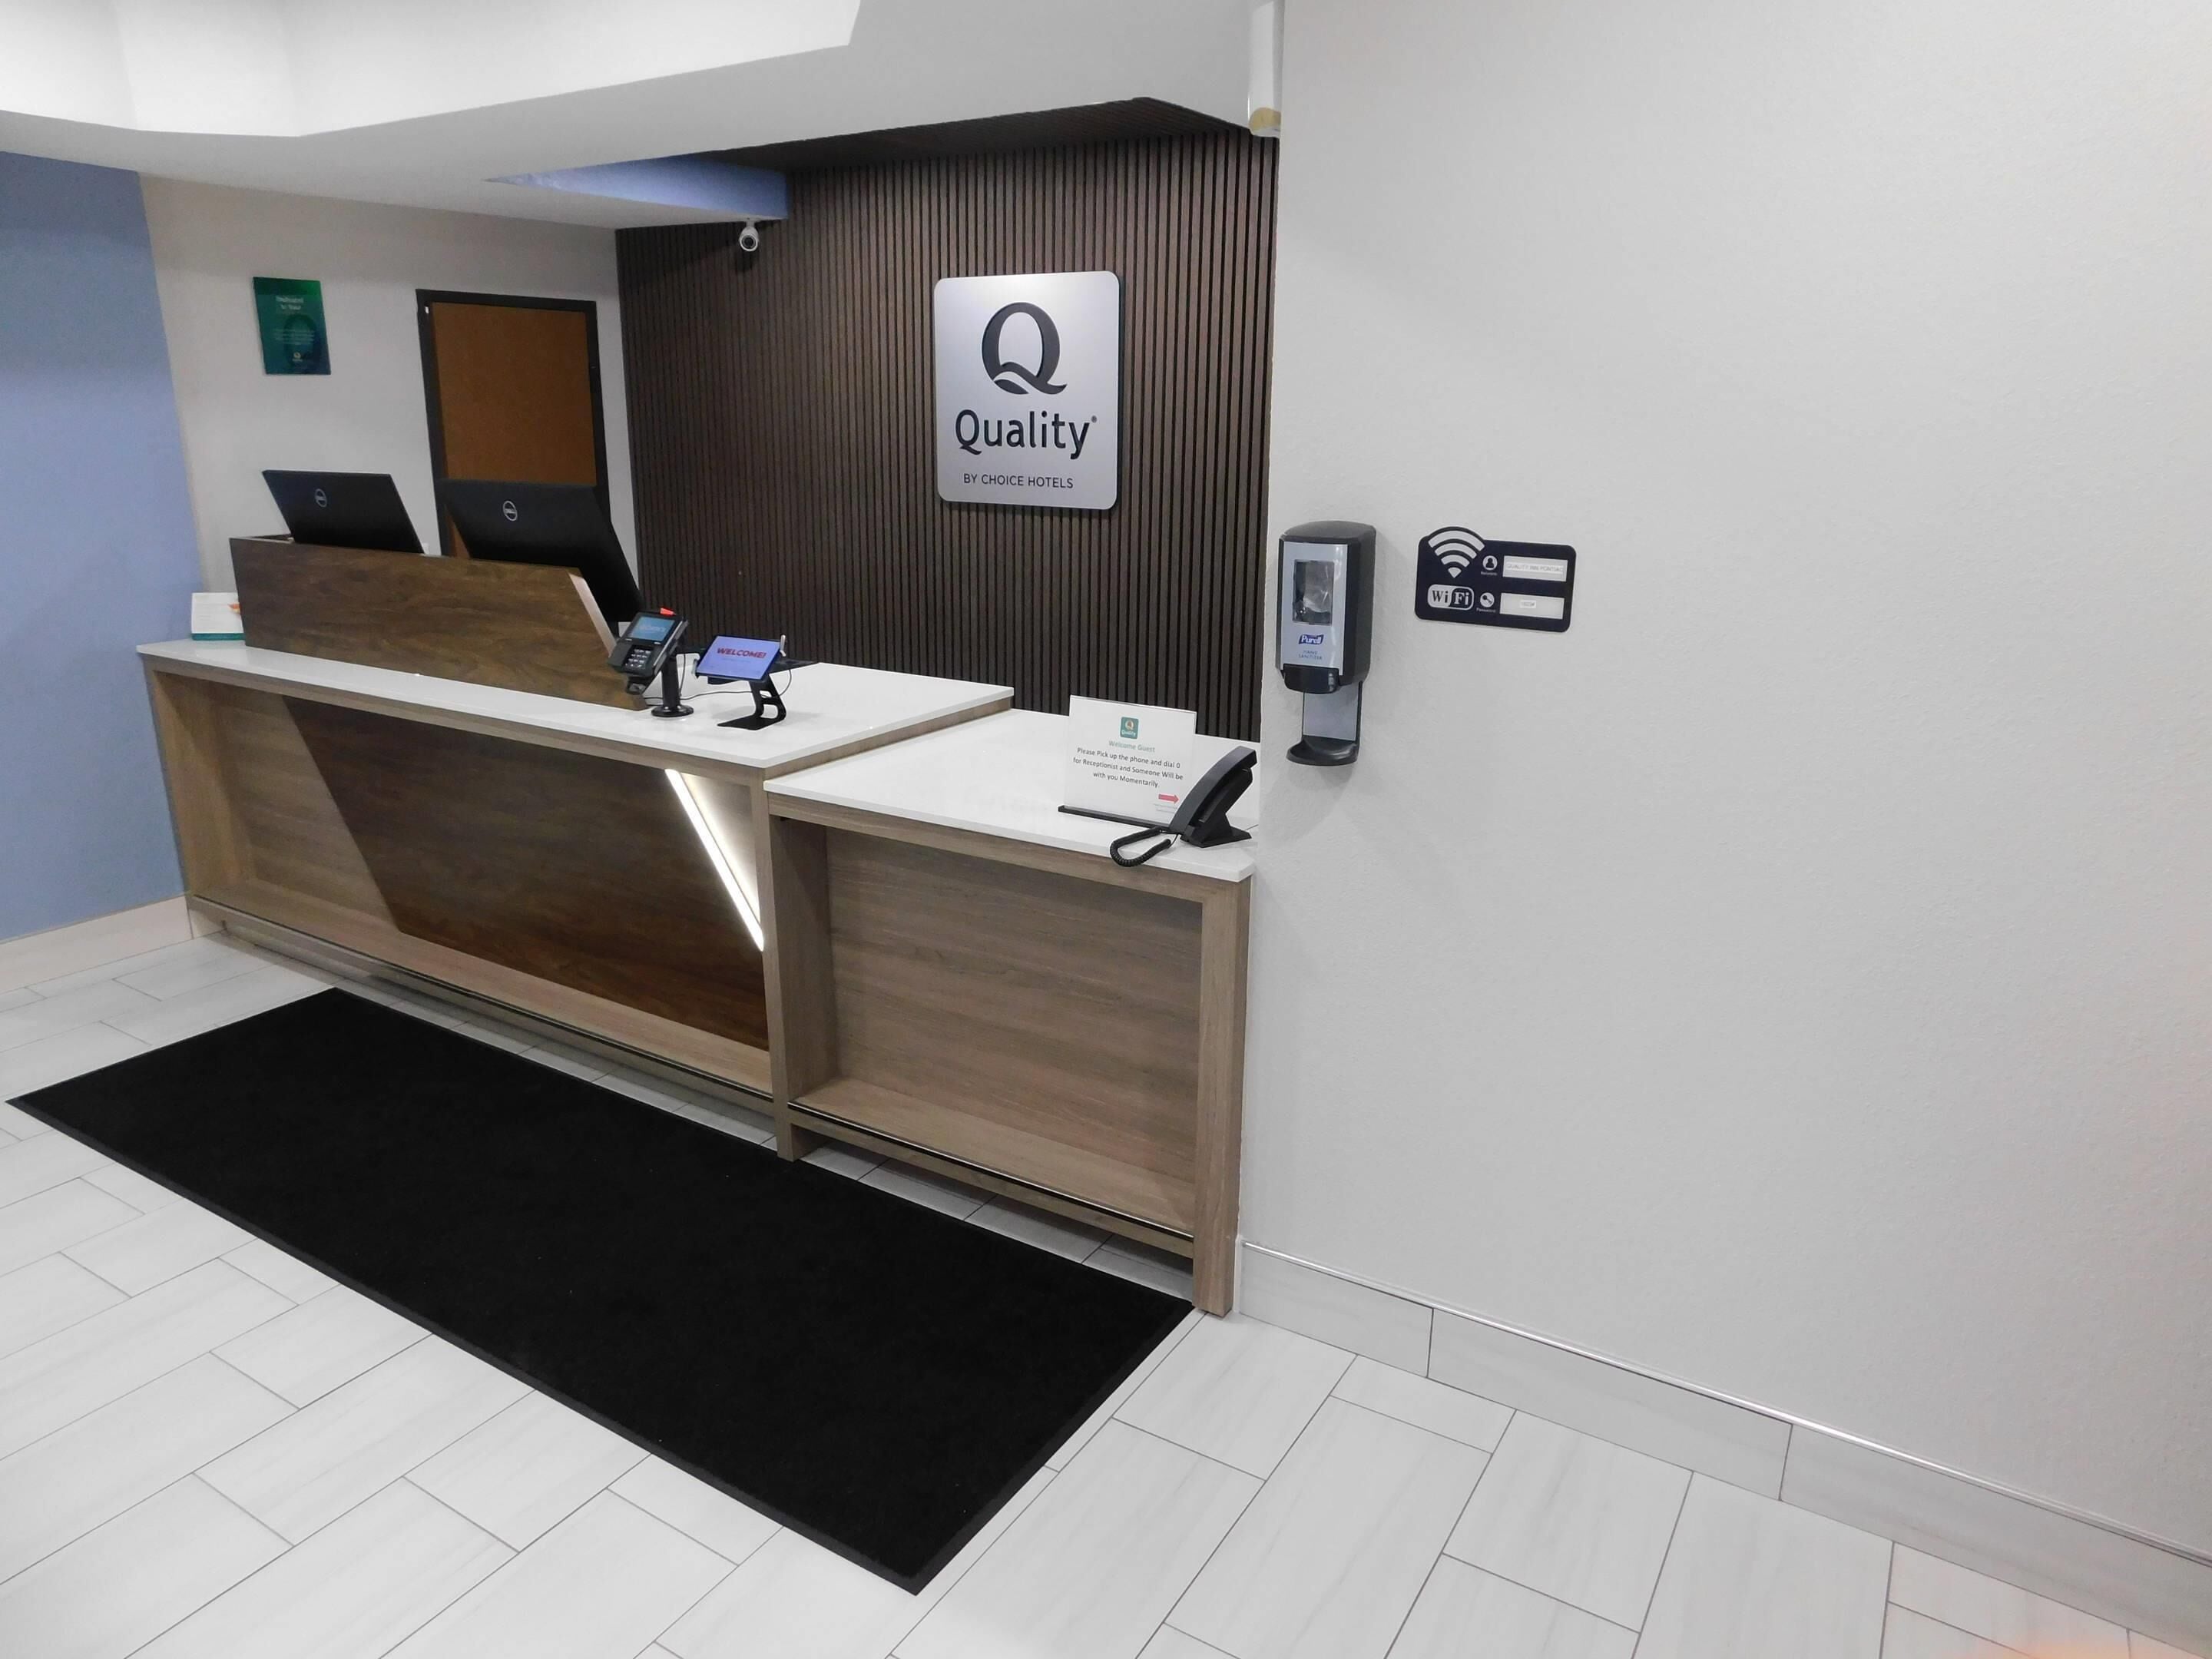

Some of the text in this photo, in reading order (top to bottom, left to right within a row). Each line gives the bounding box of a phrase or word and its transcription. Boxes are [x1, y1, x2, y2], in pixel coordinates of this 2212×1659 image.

[982, 302, 1067, 395] Q
[955, 409, 1090, 460] Quality
[963, 473, 1074, 488] BY CHOICE HOTELS
[717, 647, 767, 658] WELCOME!
[1108, 740, 1155, 753] Welcome Guest
[1077, 747, 1095, 756] Please
[1130, 756, 1149, 764] phone
[1082, 758, 1118, 770] Receptionist
[1132, 767, 1161, 777] Someone
